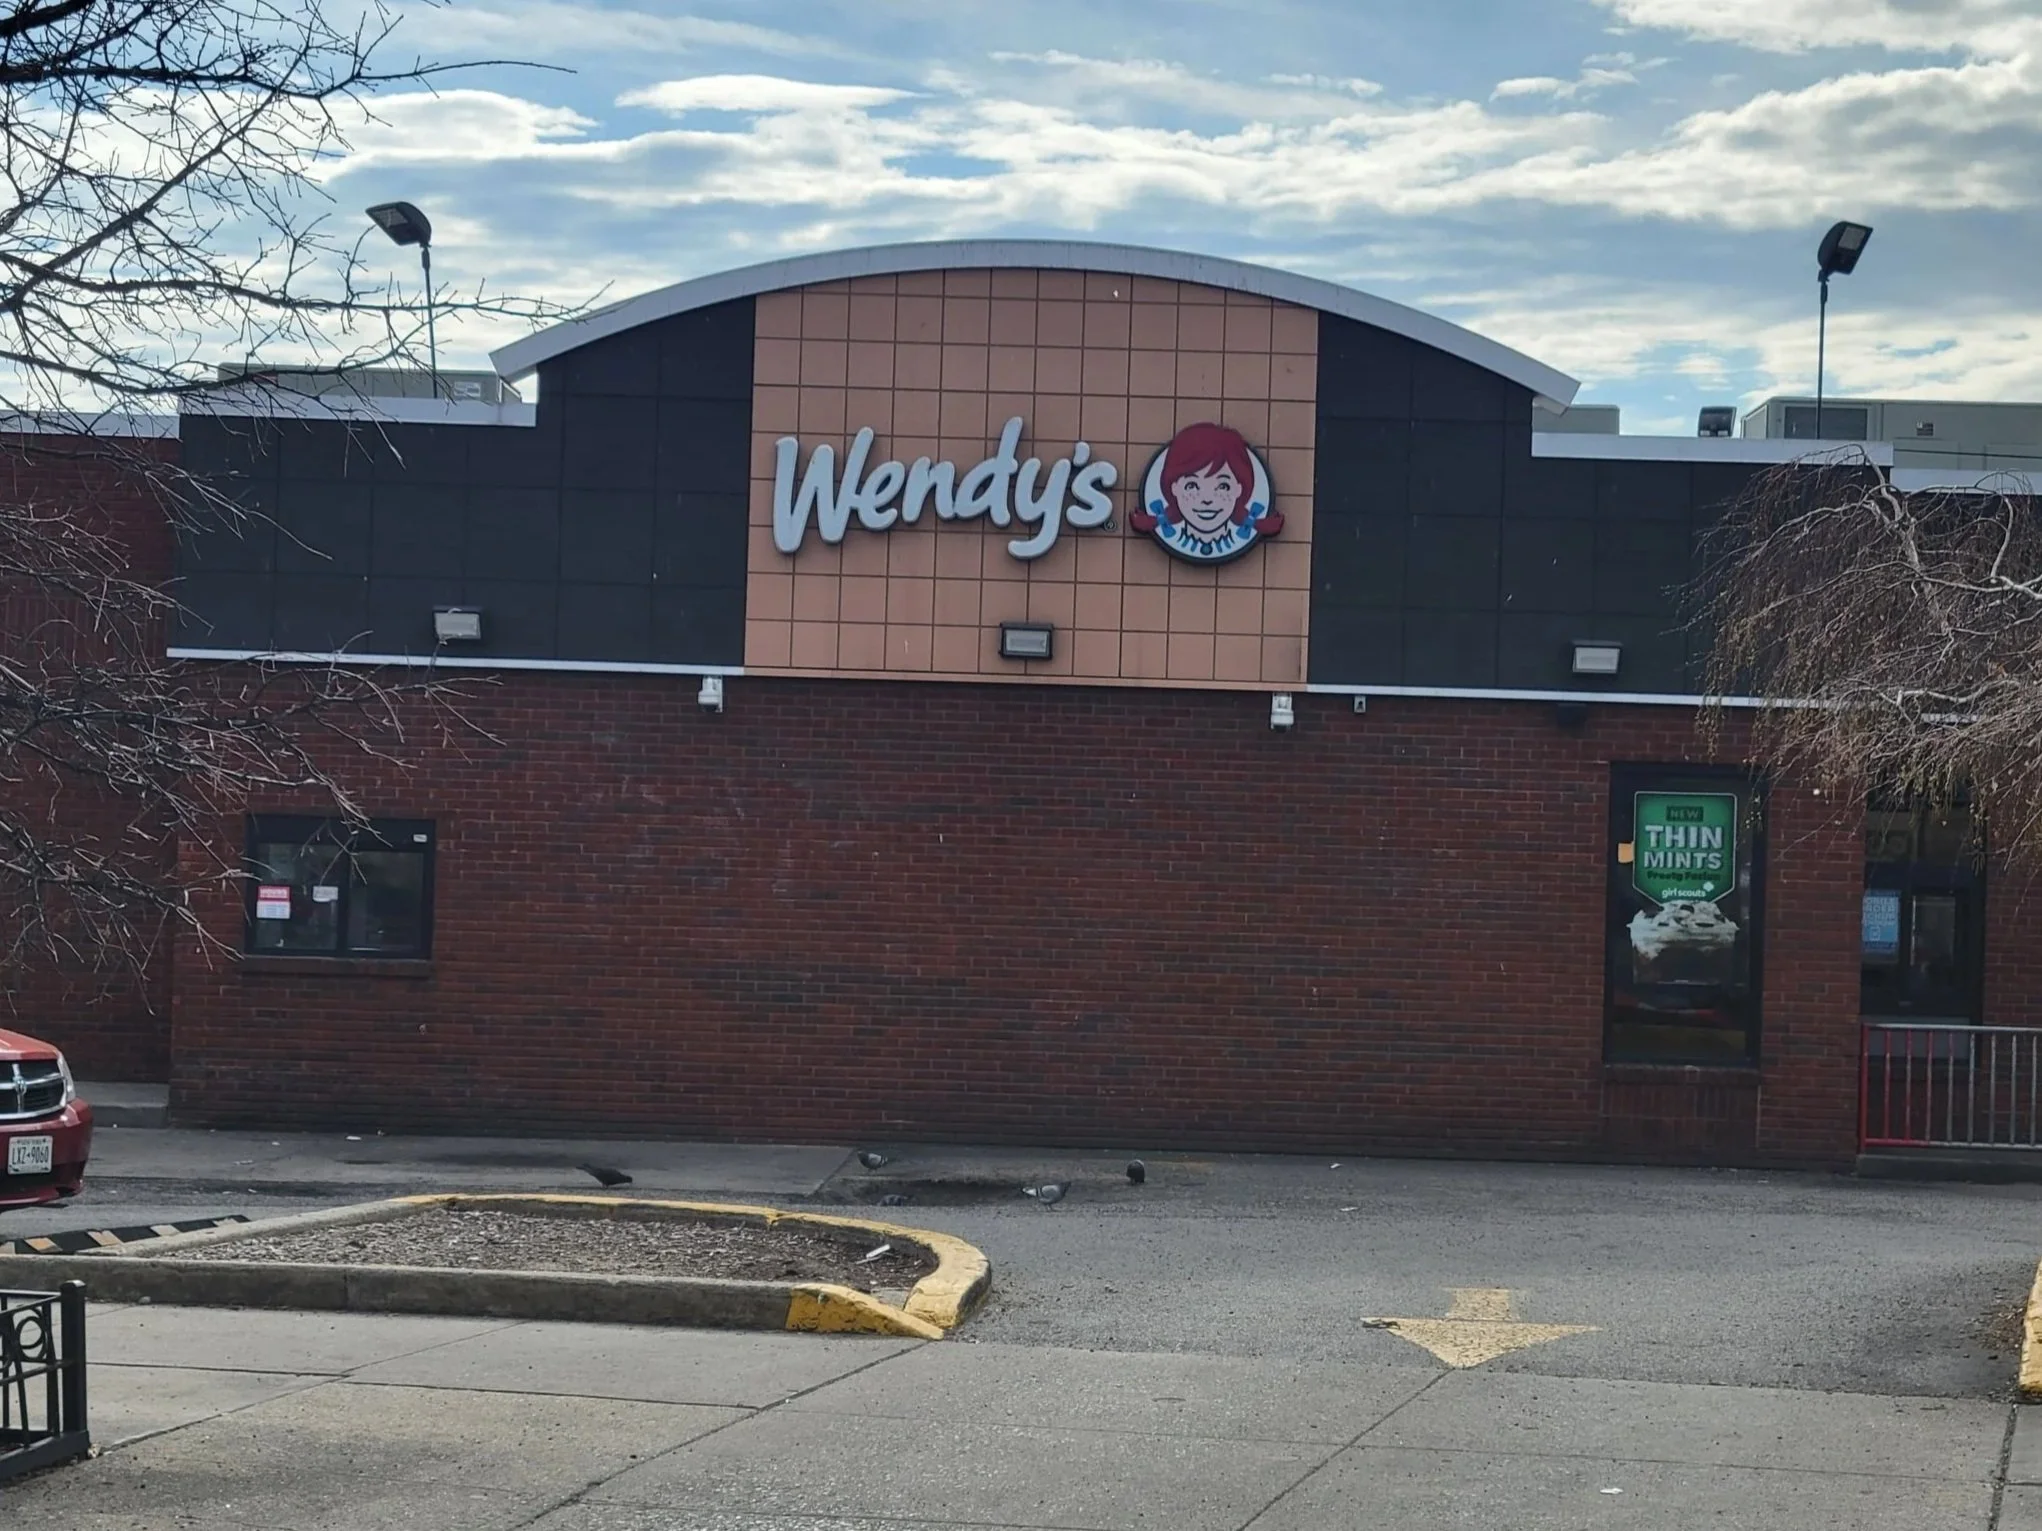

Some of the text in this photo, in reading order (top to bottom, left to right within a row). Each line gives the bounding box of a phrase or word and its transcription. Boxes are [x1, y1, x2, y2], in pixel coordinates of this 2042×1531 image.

[773, 416, 1118, 559] Wendy's
[1670, 809, 1699, 819] NEW
[1645, 824, 1722, 849] THIN
[1643, 851, 1722, 869] MINTS
[1661, 888, 1707, 899] girl scouts
